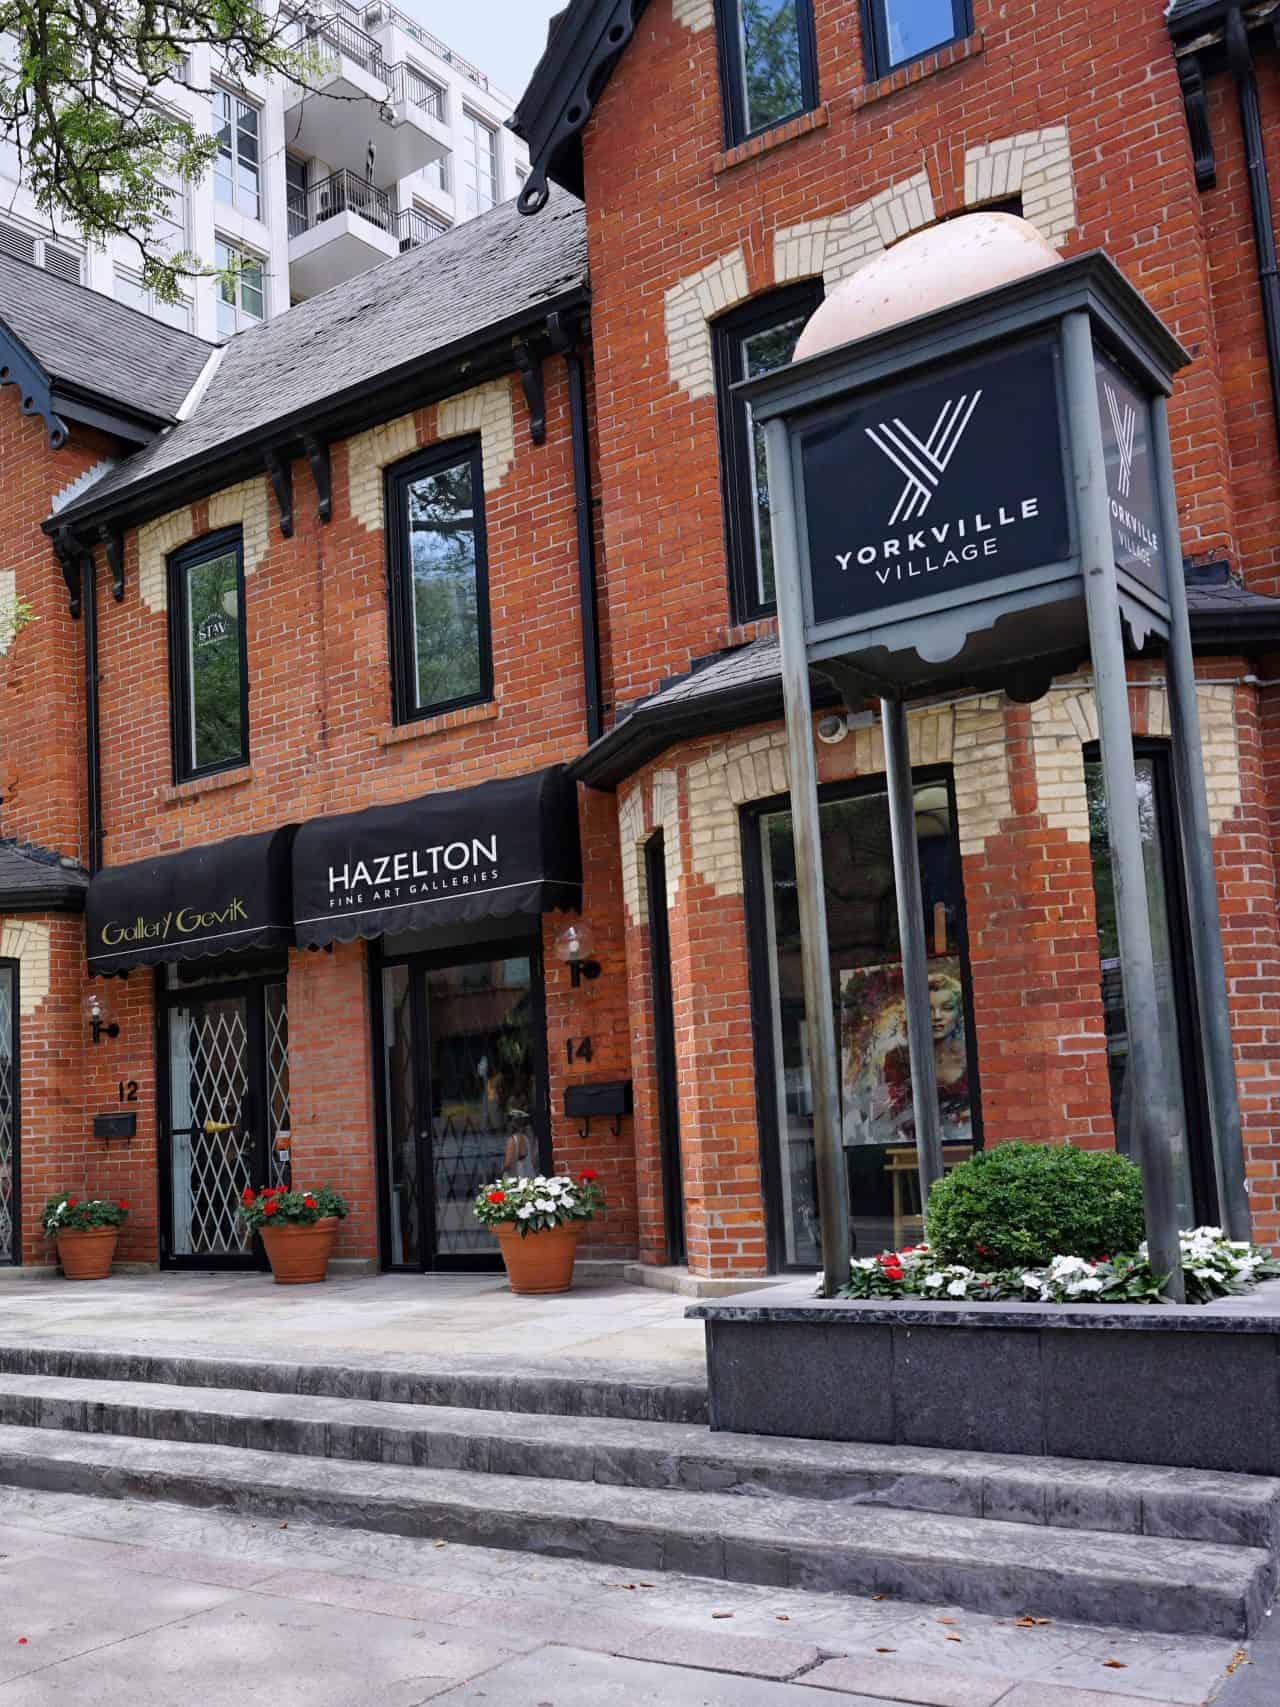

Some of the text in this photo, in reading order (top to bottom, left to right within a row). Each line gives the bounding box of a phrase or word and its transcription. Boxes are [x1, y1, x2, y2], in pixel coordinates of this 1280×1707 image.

[835, 498, 1039, 570] YORKVILLE
[875, 537, 998, 584] VILLAGE
[328, 834, 497, 893] HAZELTON
[329, 868, 499, 909] FINE ART GALLERIES
[101, 897, 248, 945] Gallery Gevik
[566, 1036, 592, 1065] 14
[119, 1080, 138, 1102] 12
